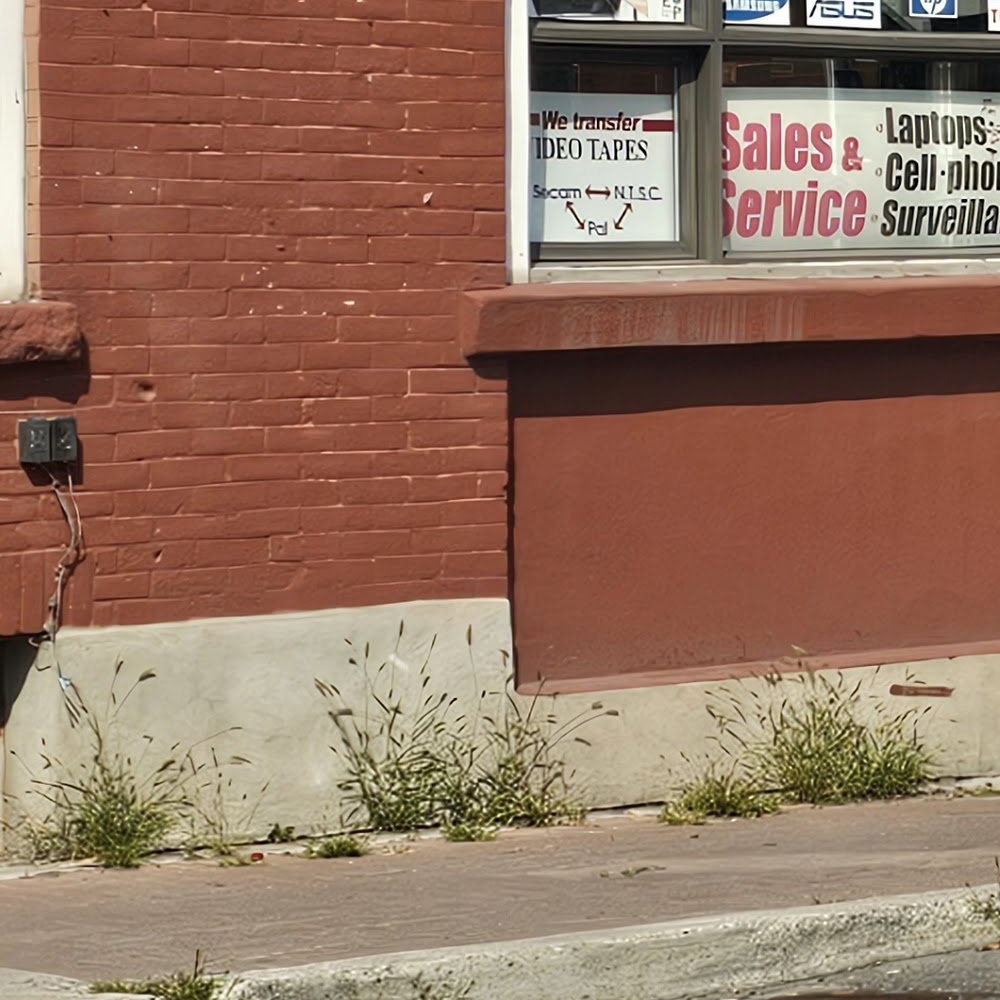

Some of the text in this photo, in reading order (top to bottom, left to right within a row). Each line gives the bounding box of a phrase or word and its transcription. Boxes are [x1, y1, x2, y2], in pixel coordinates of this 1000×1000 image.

[809, 0, 875, 20] ASUS
[542, 111, 642, 131] We transfer
[885, 107, 988, 149] Laptops
[532, 137, 649, 161] IDEO TAPES
[721, 111, 864, 172] Sales &
